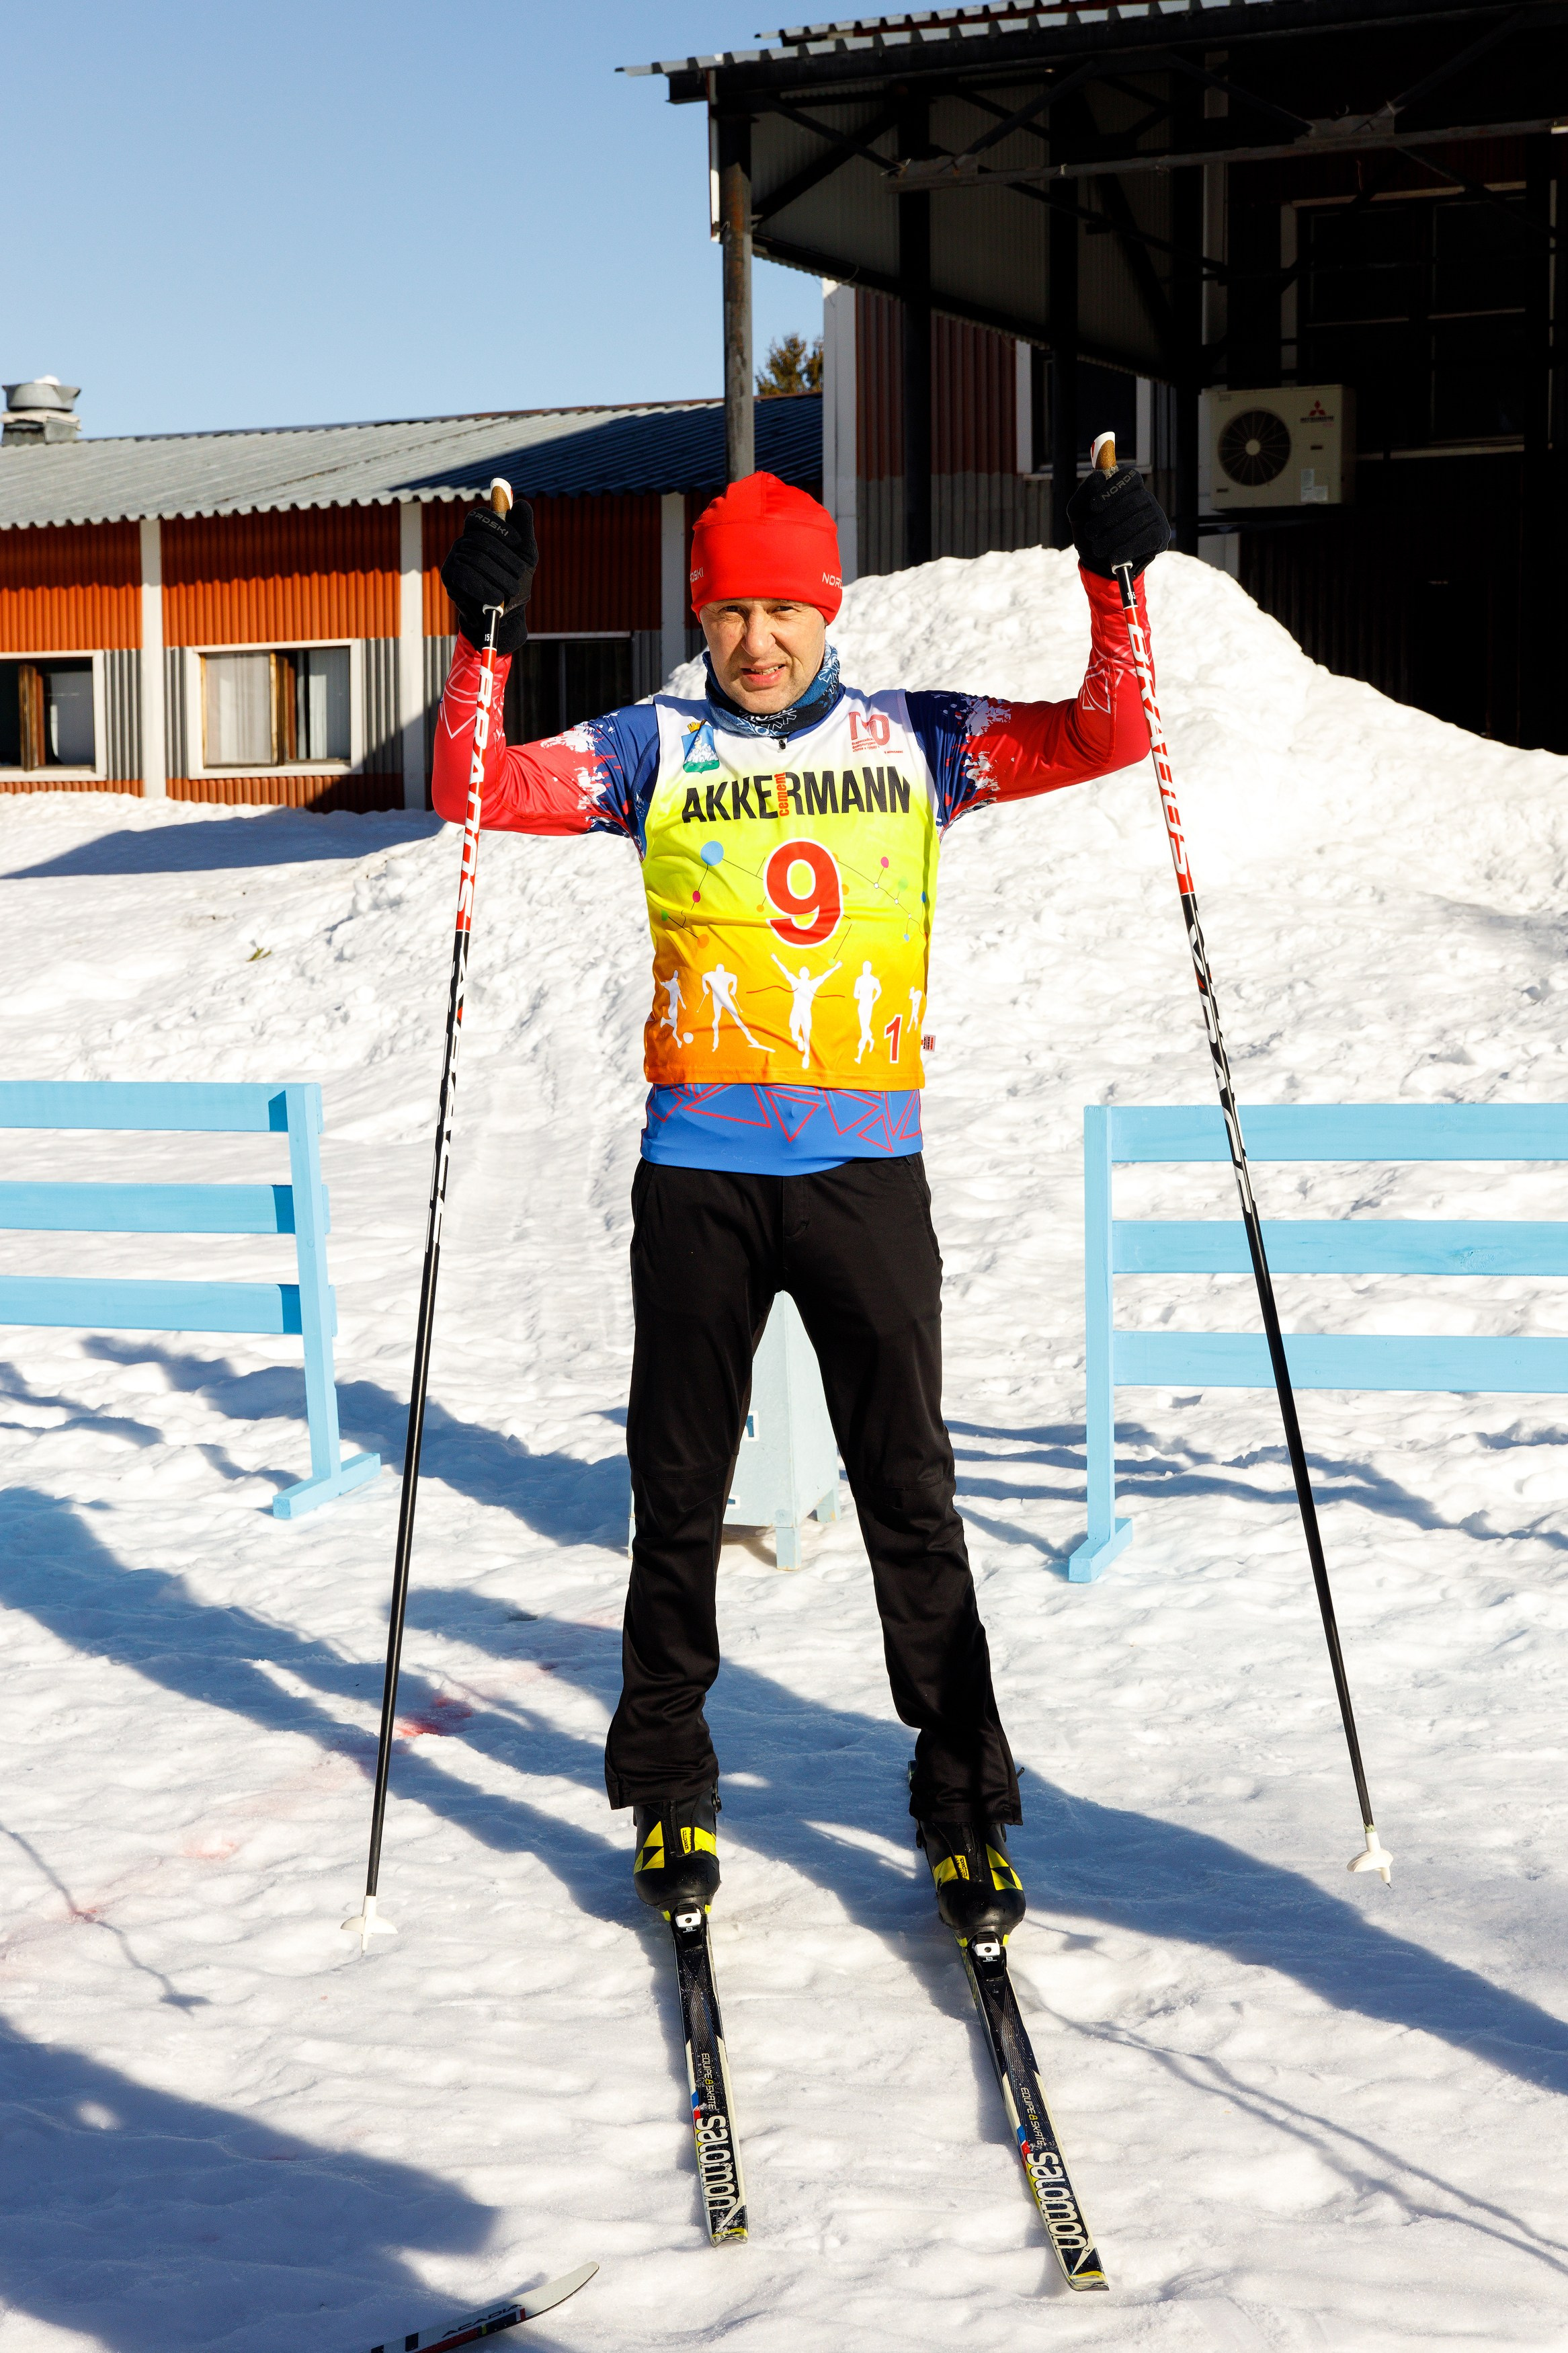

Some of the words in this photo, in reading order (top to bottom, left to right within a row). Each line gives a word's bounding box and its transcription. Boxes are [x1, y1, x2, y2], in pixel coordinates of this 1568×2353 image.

[682, 766, 911, 824] AKKERMANN
[774, 772, 790, 817] cement
[764, 838, 843, 949] 9
[884, 1014, 903, 1064] 1
[701, 2052, 713, 2079] EQUIPE
[706, 2085, 716, 2110] SKATE
[1020, 2087, 1036, 2115] EQUIPE
[1030, 2120, 1046, 2146] SKATE
[442, 2304, 522, 2338] ACADIA
